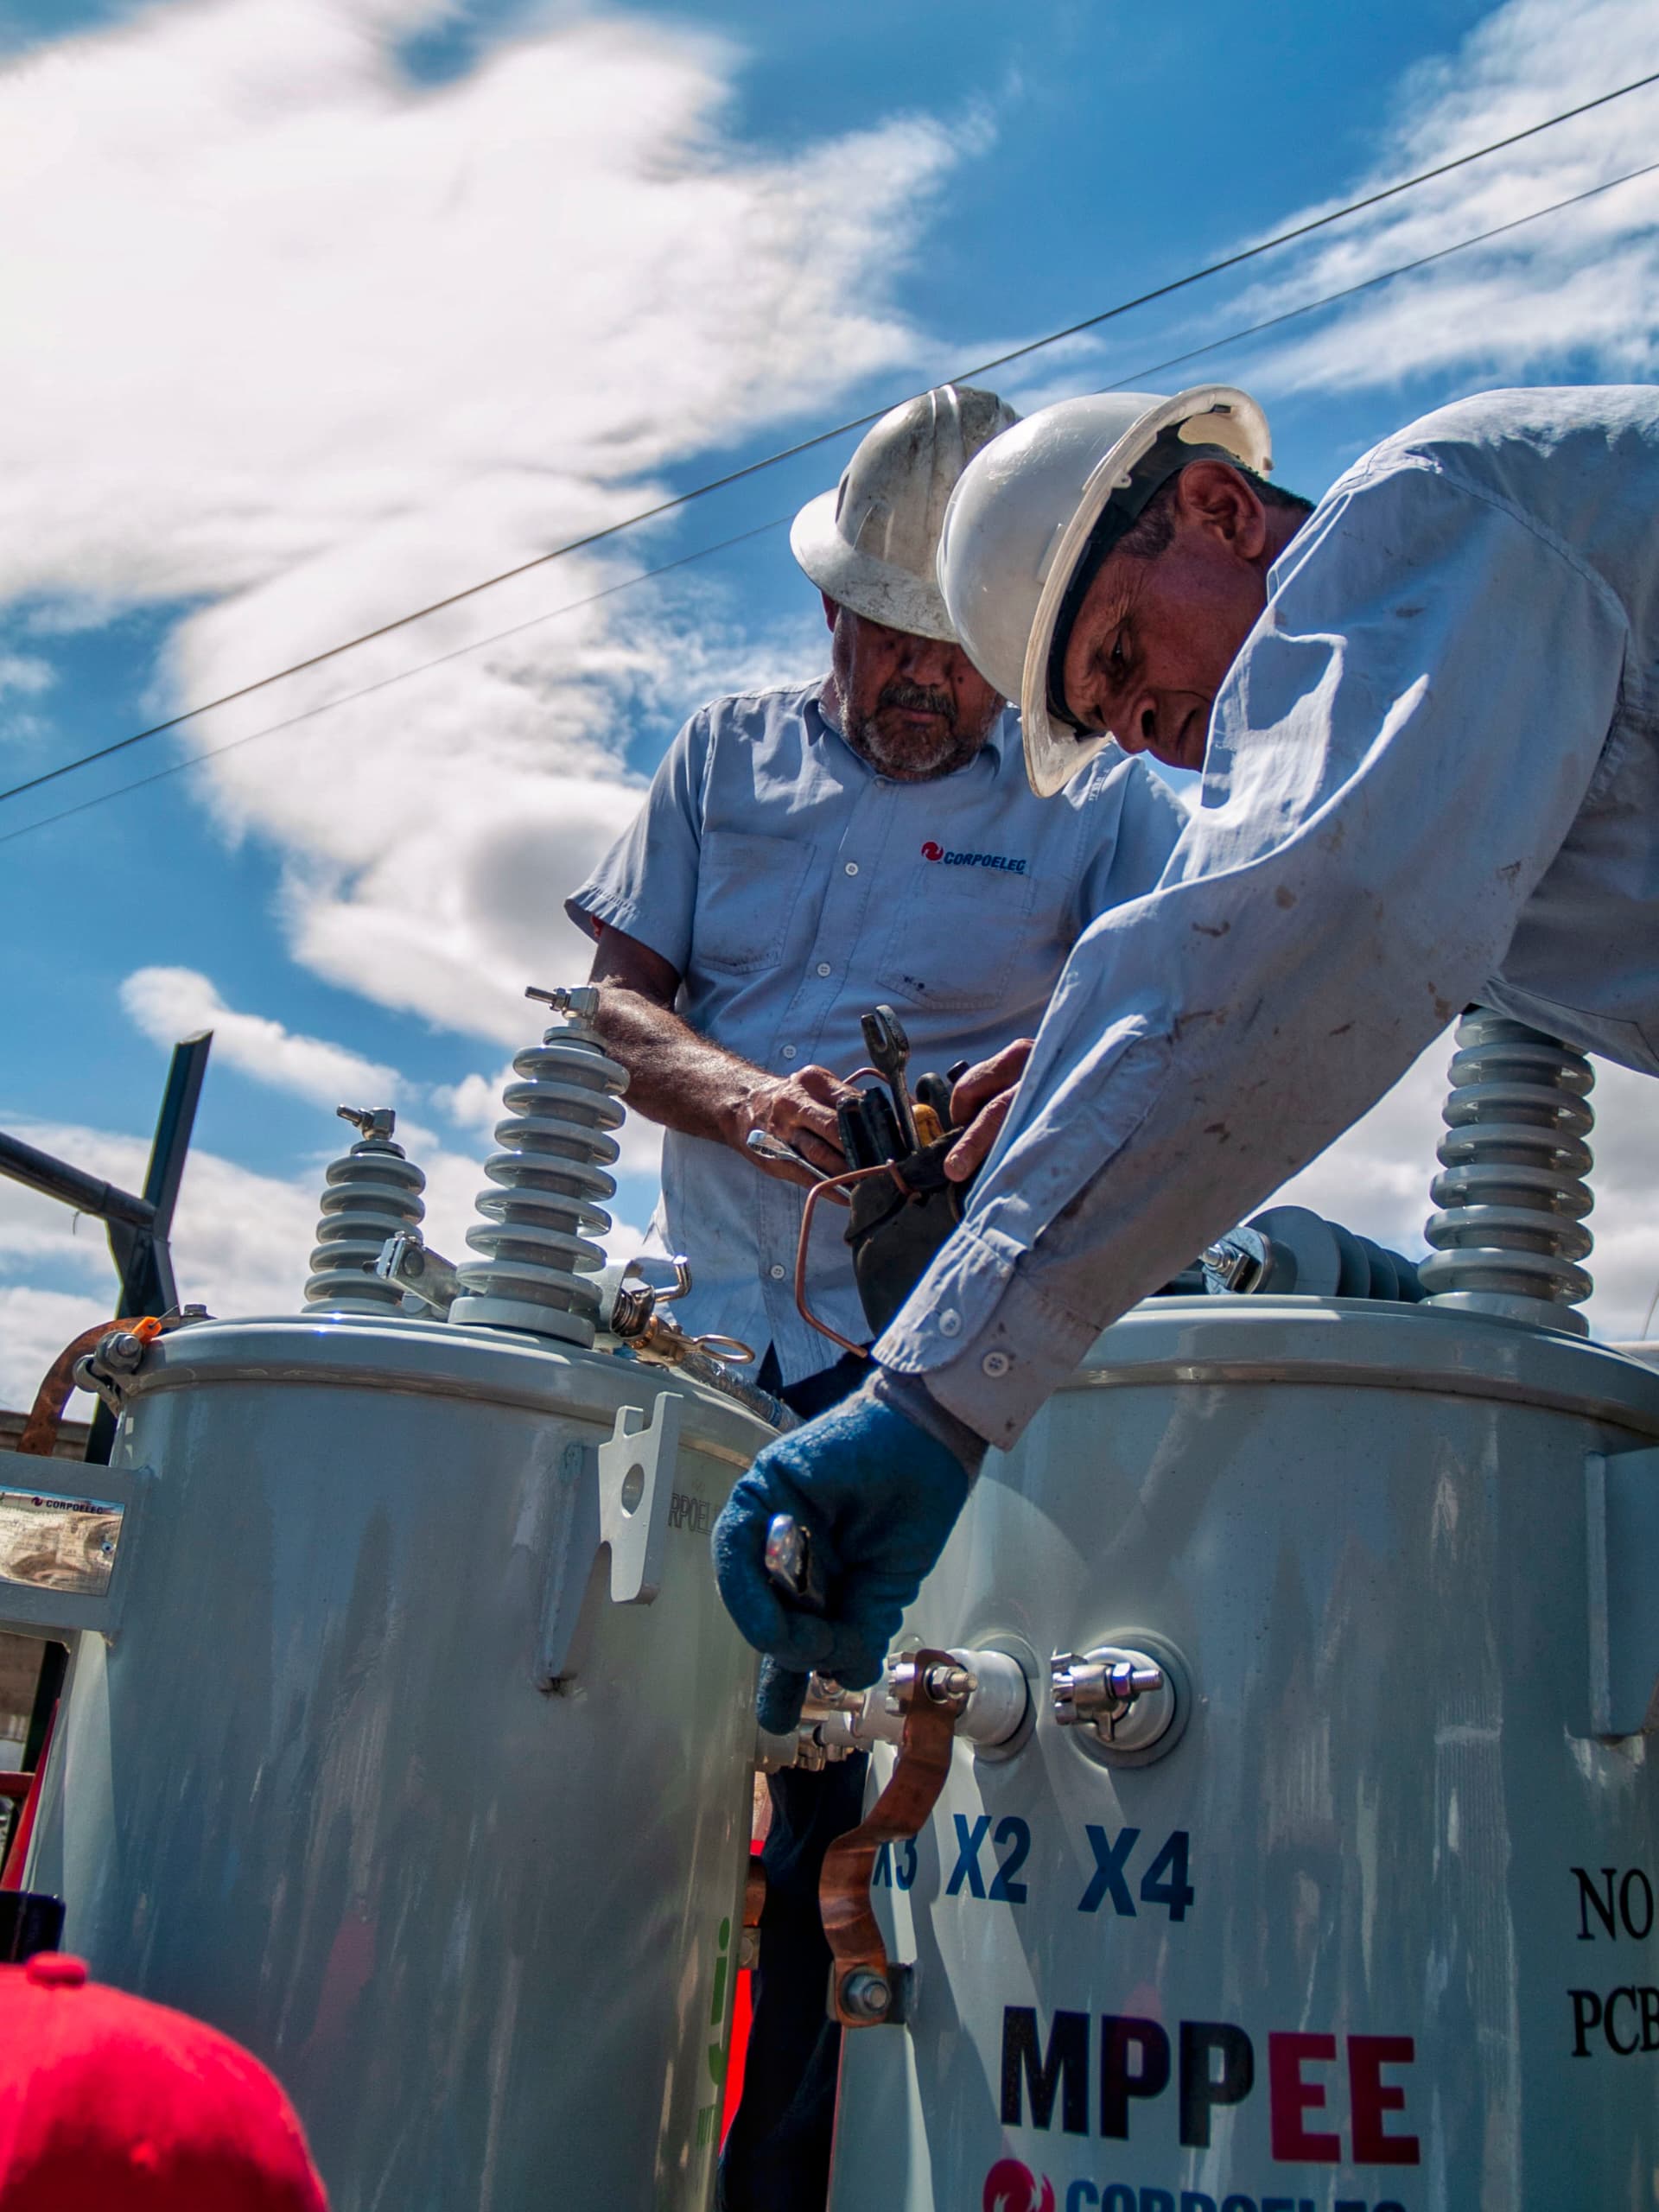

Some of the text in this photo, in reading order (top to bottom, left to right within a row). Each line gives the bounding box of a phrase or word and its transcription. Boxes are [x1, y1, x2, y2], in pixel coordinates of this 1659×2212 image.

[944, 851, 1027, 872] CORPOELEC
[946, 1813, 1031, 1904] X2
[1077, 1824, 1194, 1922] X4
[1570, 1866, 1654, 1941] NO
[1001, 2005, 1420, 2164] MPPEE
